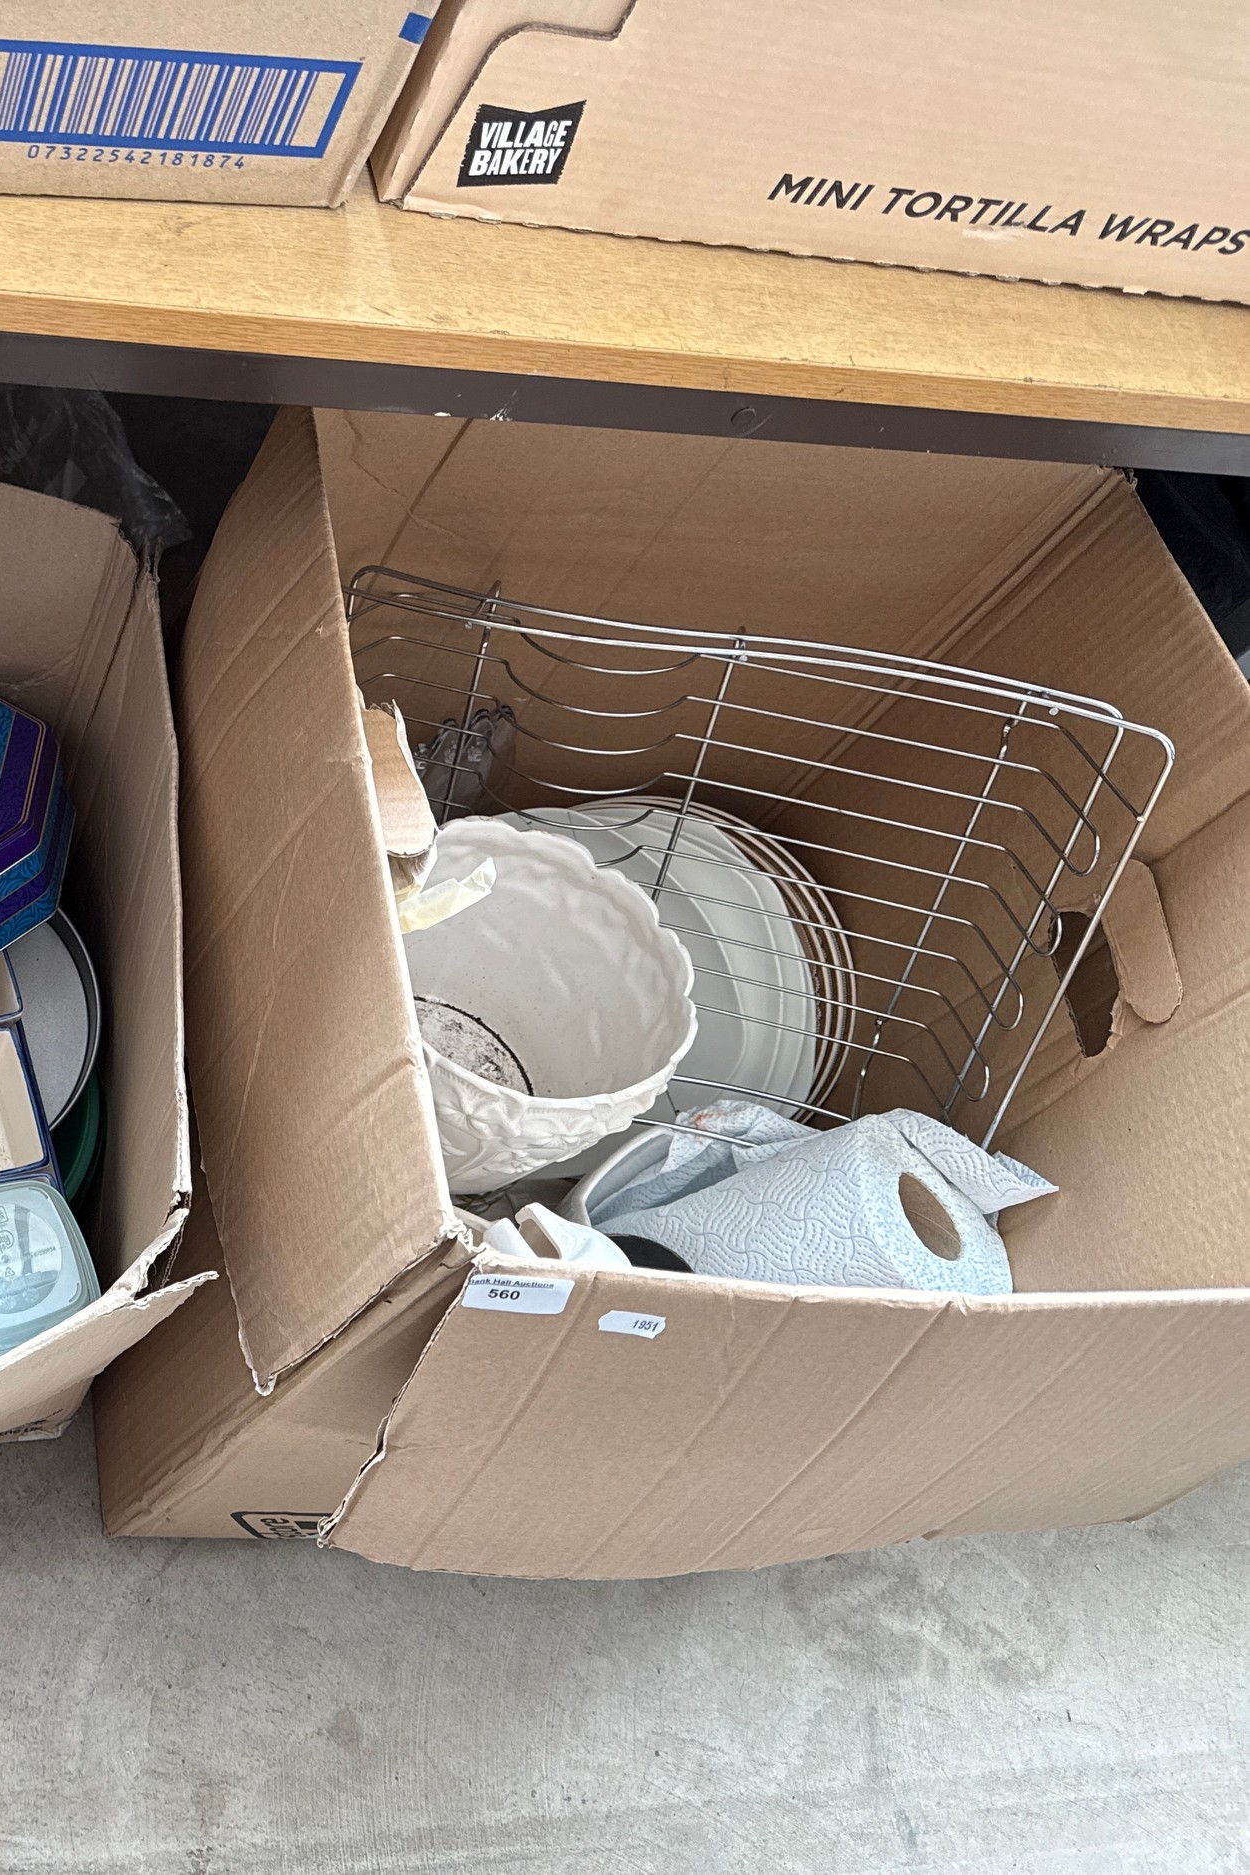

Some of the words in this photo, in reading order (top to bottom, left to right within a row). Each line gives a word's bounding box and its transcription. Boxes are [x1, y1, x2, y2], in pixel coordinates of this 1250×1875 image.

[479, 120, 573, 148] VILLAGE
[27, 144, 245, 170] 07322542181874
[468, 147, 563, 177] BAKERY
[767, 173, 876, 211] MINI
[882, 186, 1087, 237] TORTILLA
[1097, 212, 1250, 256] WRAPS
[487, 1288, 521, 1301] 560
[493, 1278, 512, 1287] Hall
[512, 1280, 555, 1289] Auctions
[632, 1319, 659, 1332] 1951
